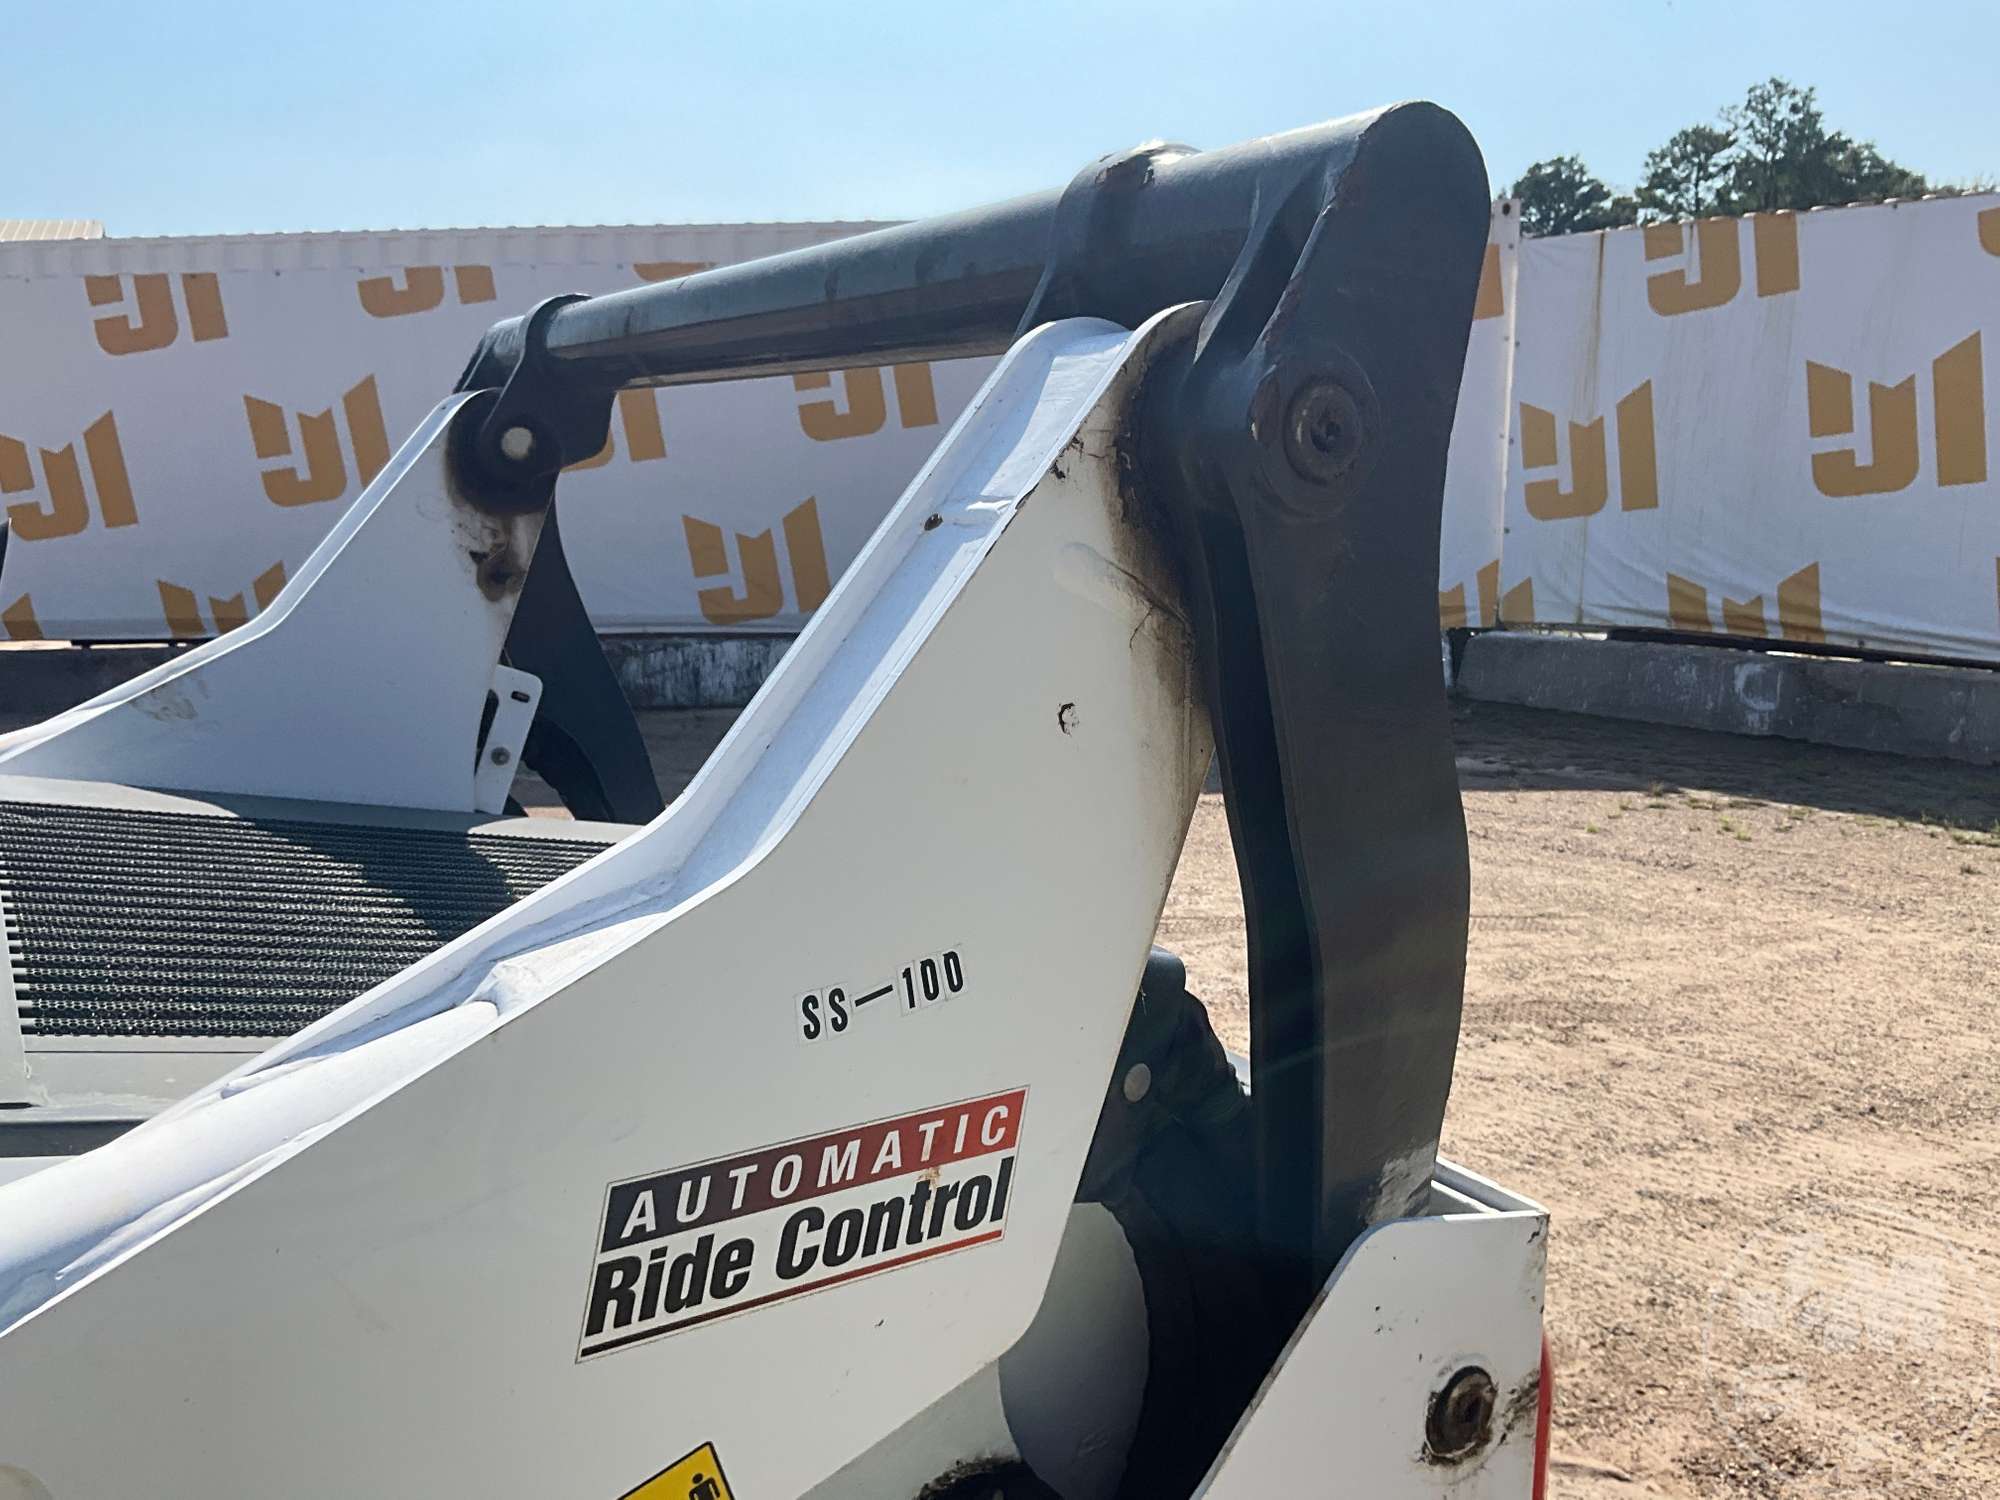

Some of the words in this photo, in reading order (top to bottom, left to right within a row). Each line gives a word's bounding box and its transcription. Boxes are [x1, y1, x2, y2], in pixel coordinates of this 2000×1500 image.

[584, 1233, 754, 1338] Ride
[775, 1155, 1015, 1281] Control
[620, 1104, 1009, 1239] AUTOMATIC
